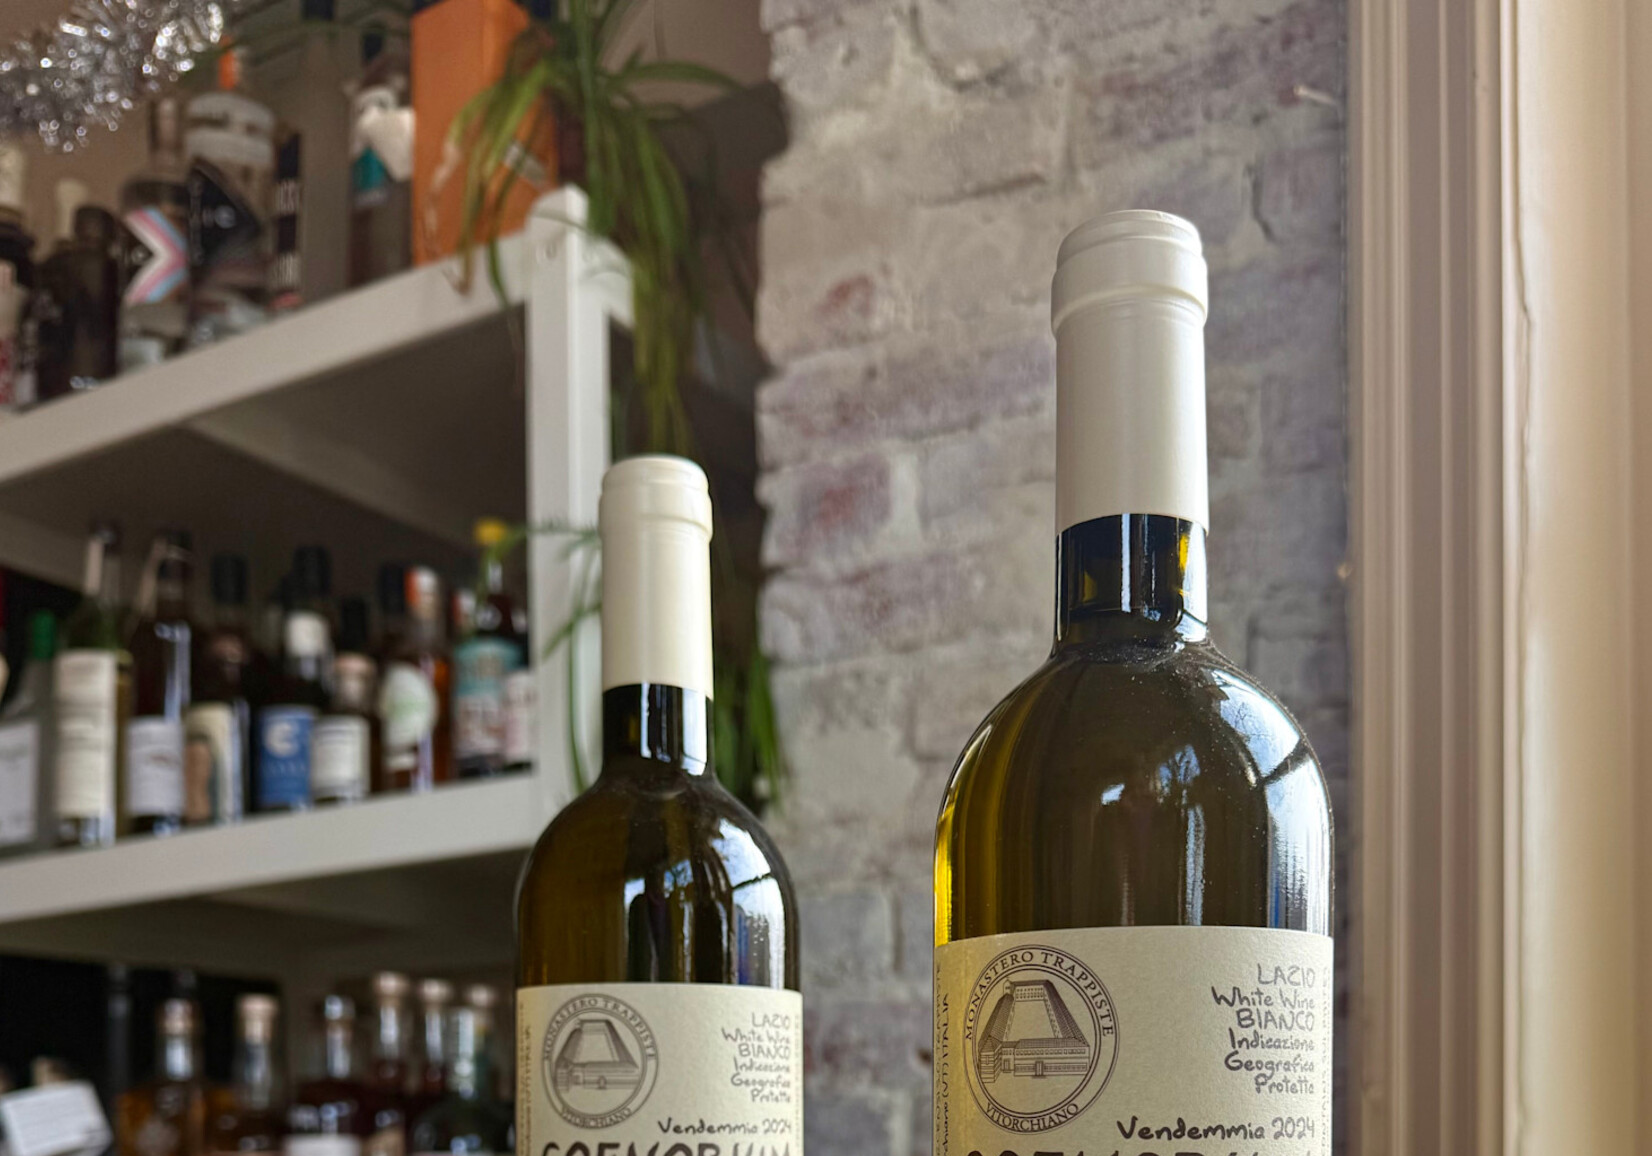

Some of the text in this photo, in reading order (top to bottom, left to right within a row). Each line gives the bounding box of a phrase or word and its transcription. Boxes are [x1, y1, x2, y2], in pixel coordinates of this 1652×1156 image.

[1257, 963, 1315, 988] LAZIO
[965, 951, 1114, 1040] MONASTERO TRAPPISTE
[1211, 986, 1315, 1009] White Wine
[751, 1013, 791, 1029] LAZIO
[1236, 1008, 1315, 1031] BIANCO
[721, 1027, 764, 1044] White
[1229, 1027, 1314, 1050] Indicazione
[738, 1043, 791, 1060] BIANCO
[1224, 1050, 1314, 1079] Geografica
[1255, 1073, 1314, 1094] Protetta
[658, 1117, 792, 1134] Vendemmia 2024
[986, 1102, 1079, 1131] VITORCHIANO
[1117, 1116, 1315, 1141] Vendemmia 2024
